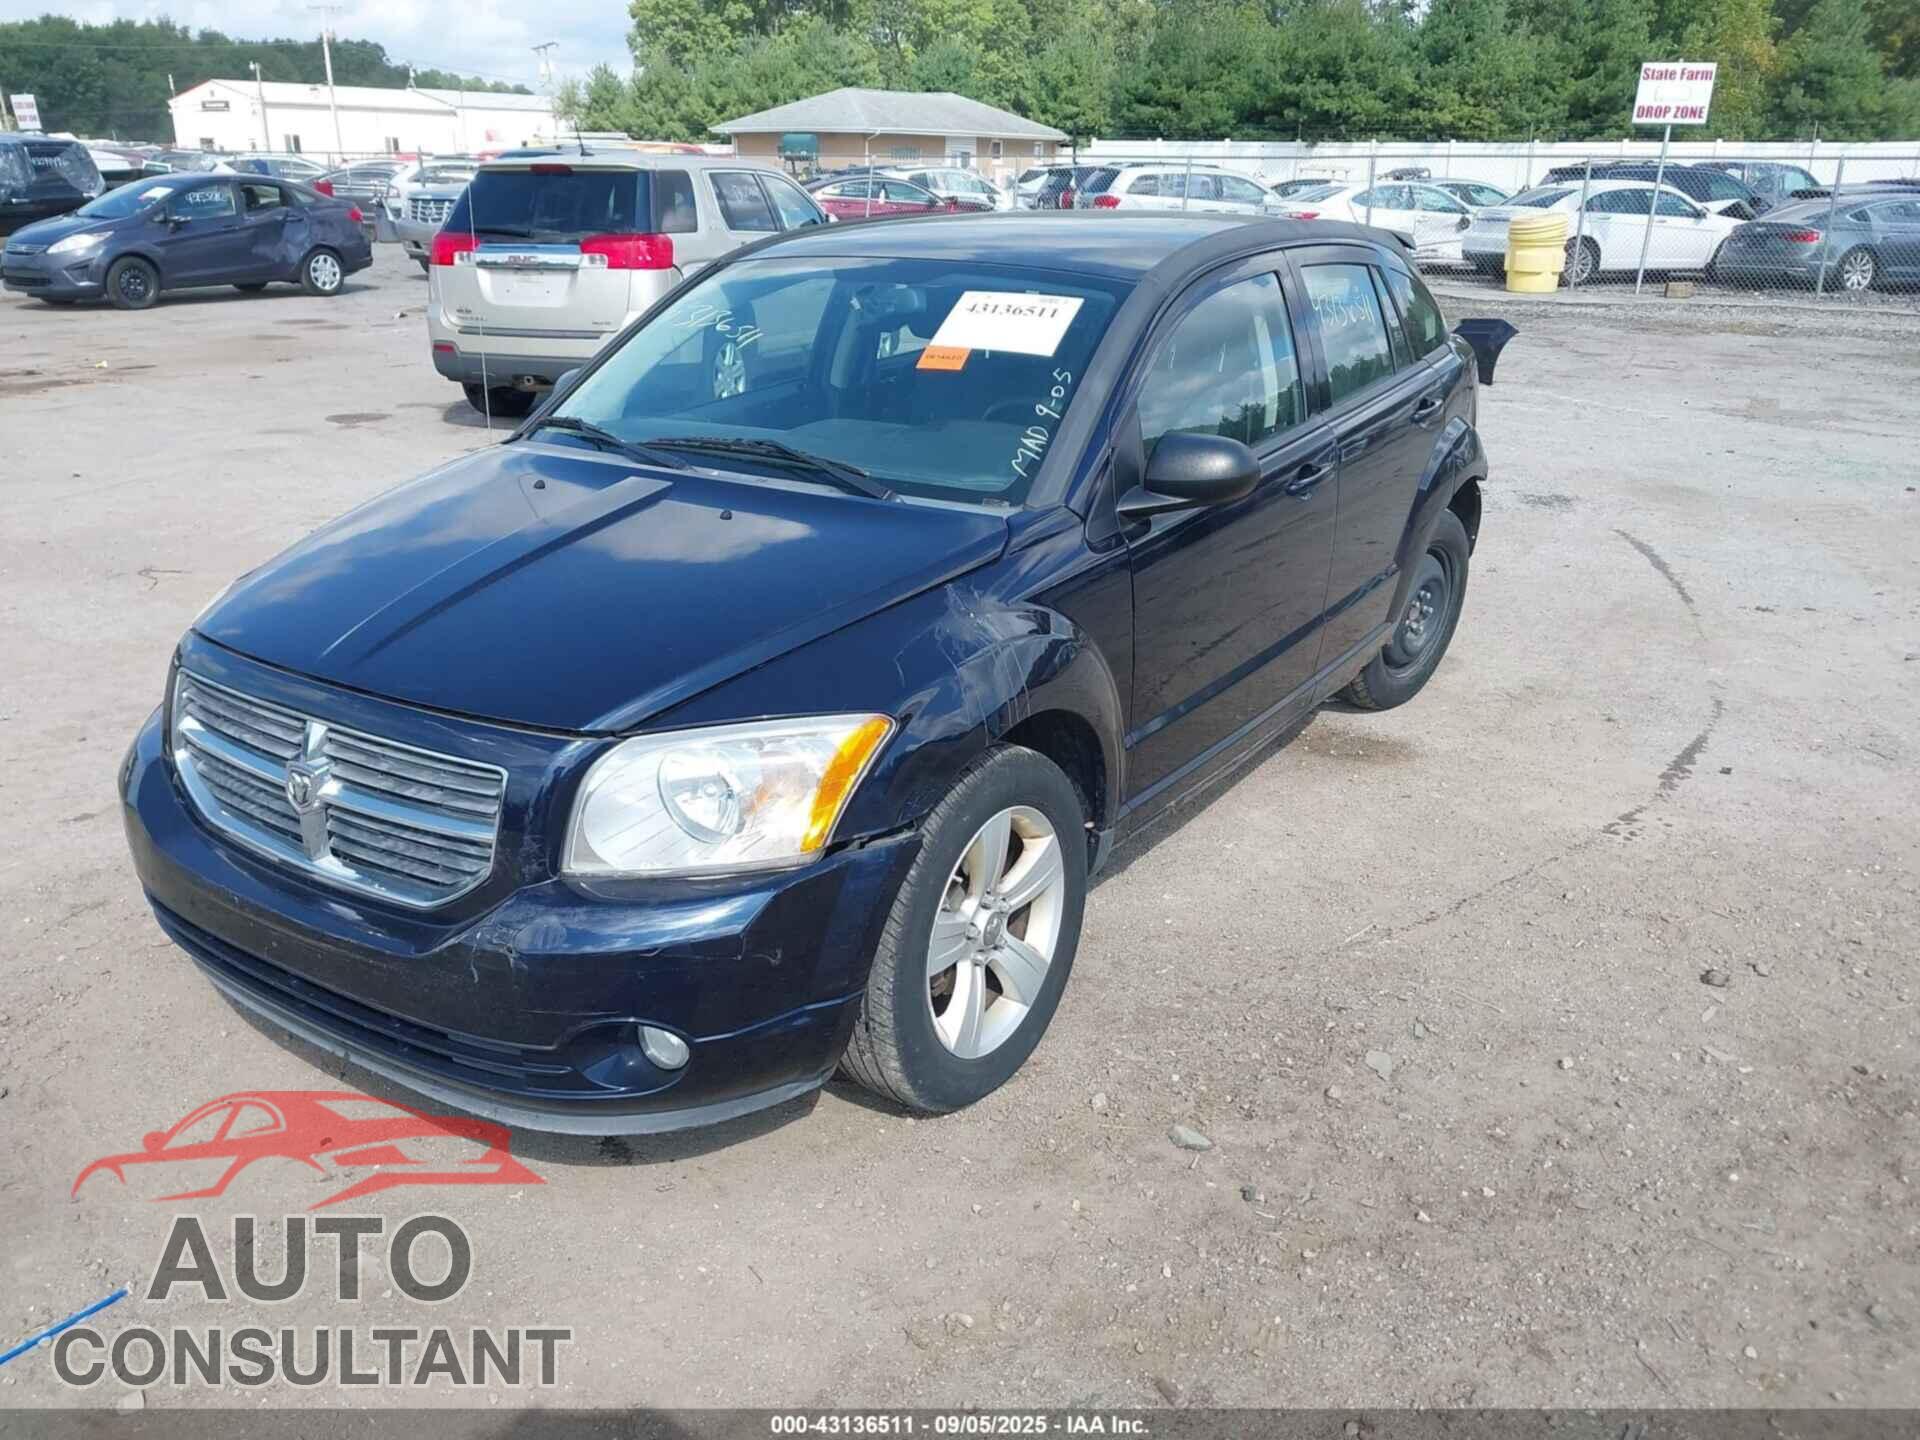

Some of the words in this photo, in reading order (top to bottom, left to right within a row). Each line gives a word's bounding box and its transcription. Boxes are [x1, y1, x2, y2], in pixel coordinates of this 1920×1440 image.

[1643, 67, 1677, 81] State
[1680, 67, 1713, 81] Farm
[1636, 105, 1671, 119] DROP
[1673, 105, 1706, 119] ZONE
[965, 302, 1059, 319] 43136511
[1011, 425, 1049, 478] MAD
[1035, 367, 1072, 419] 9-05
